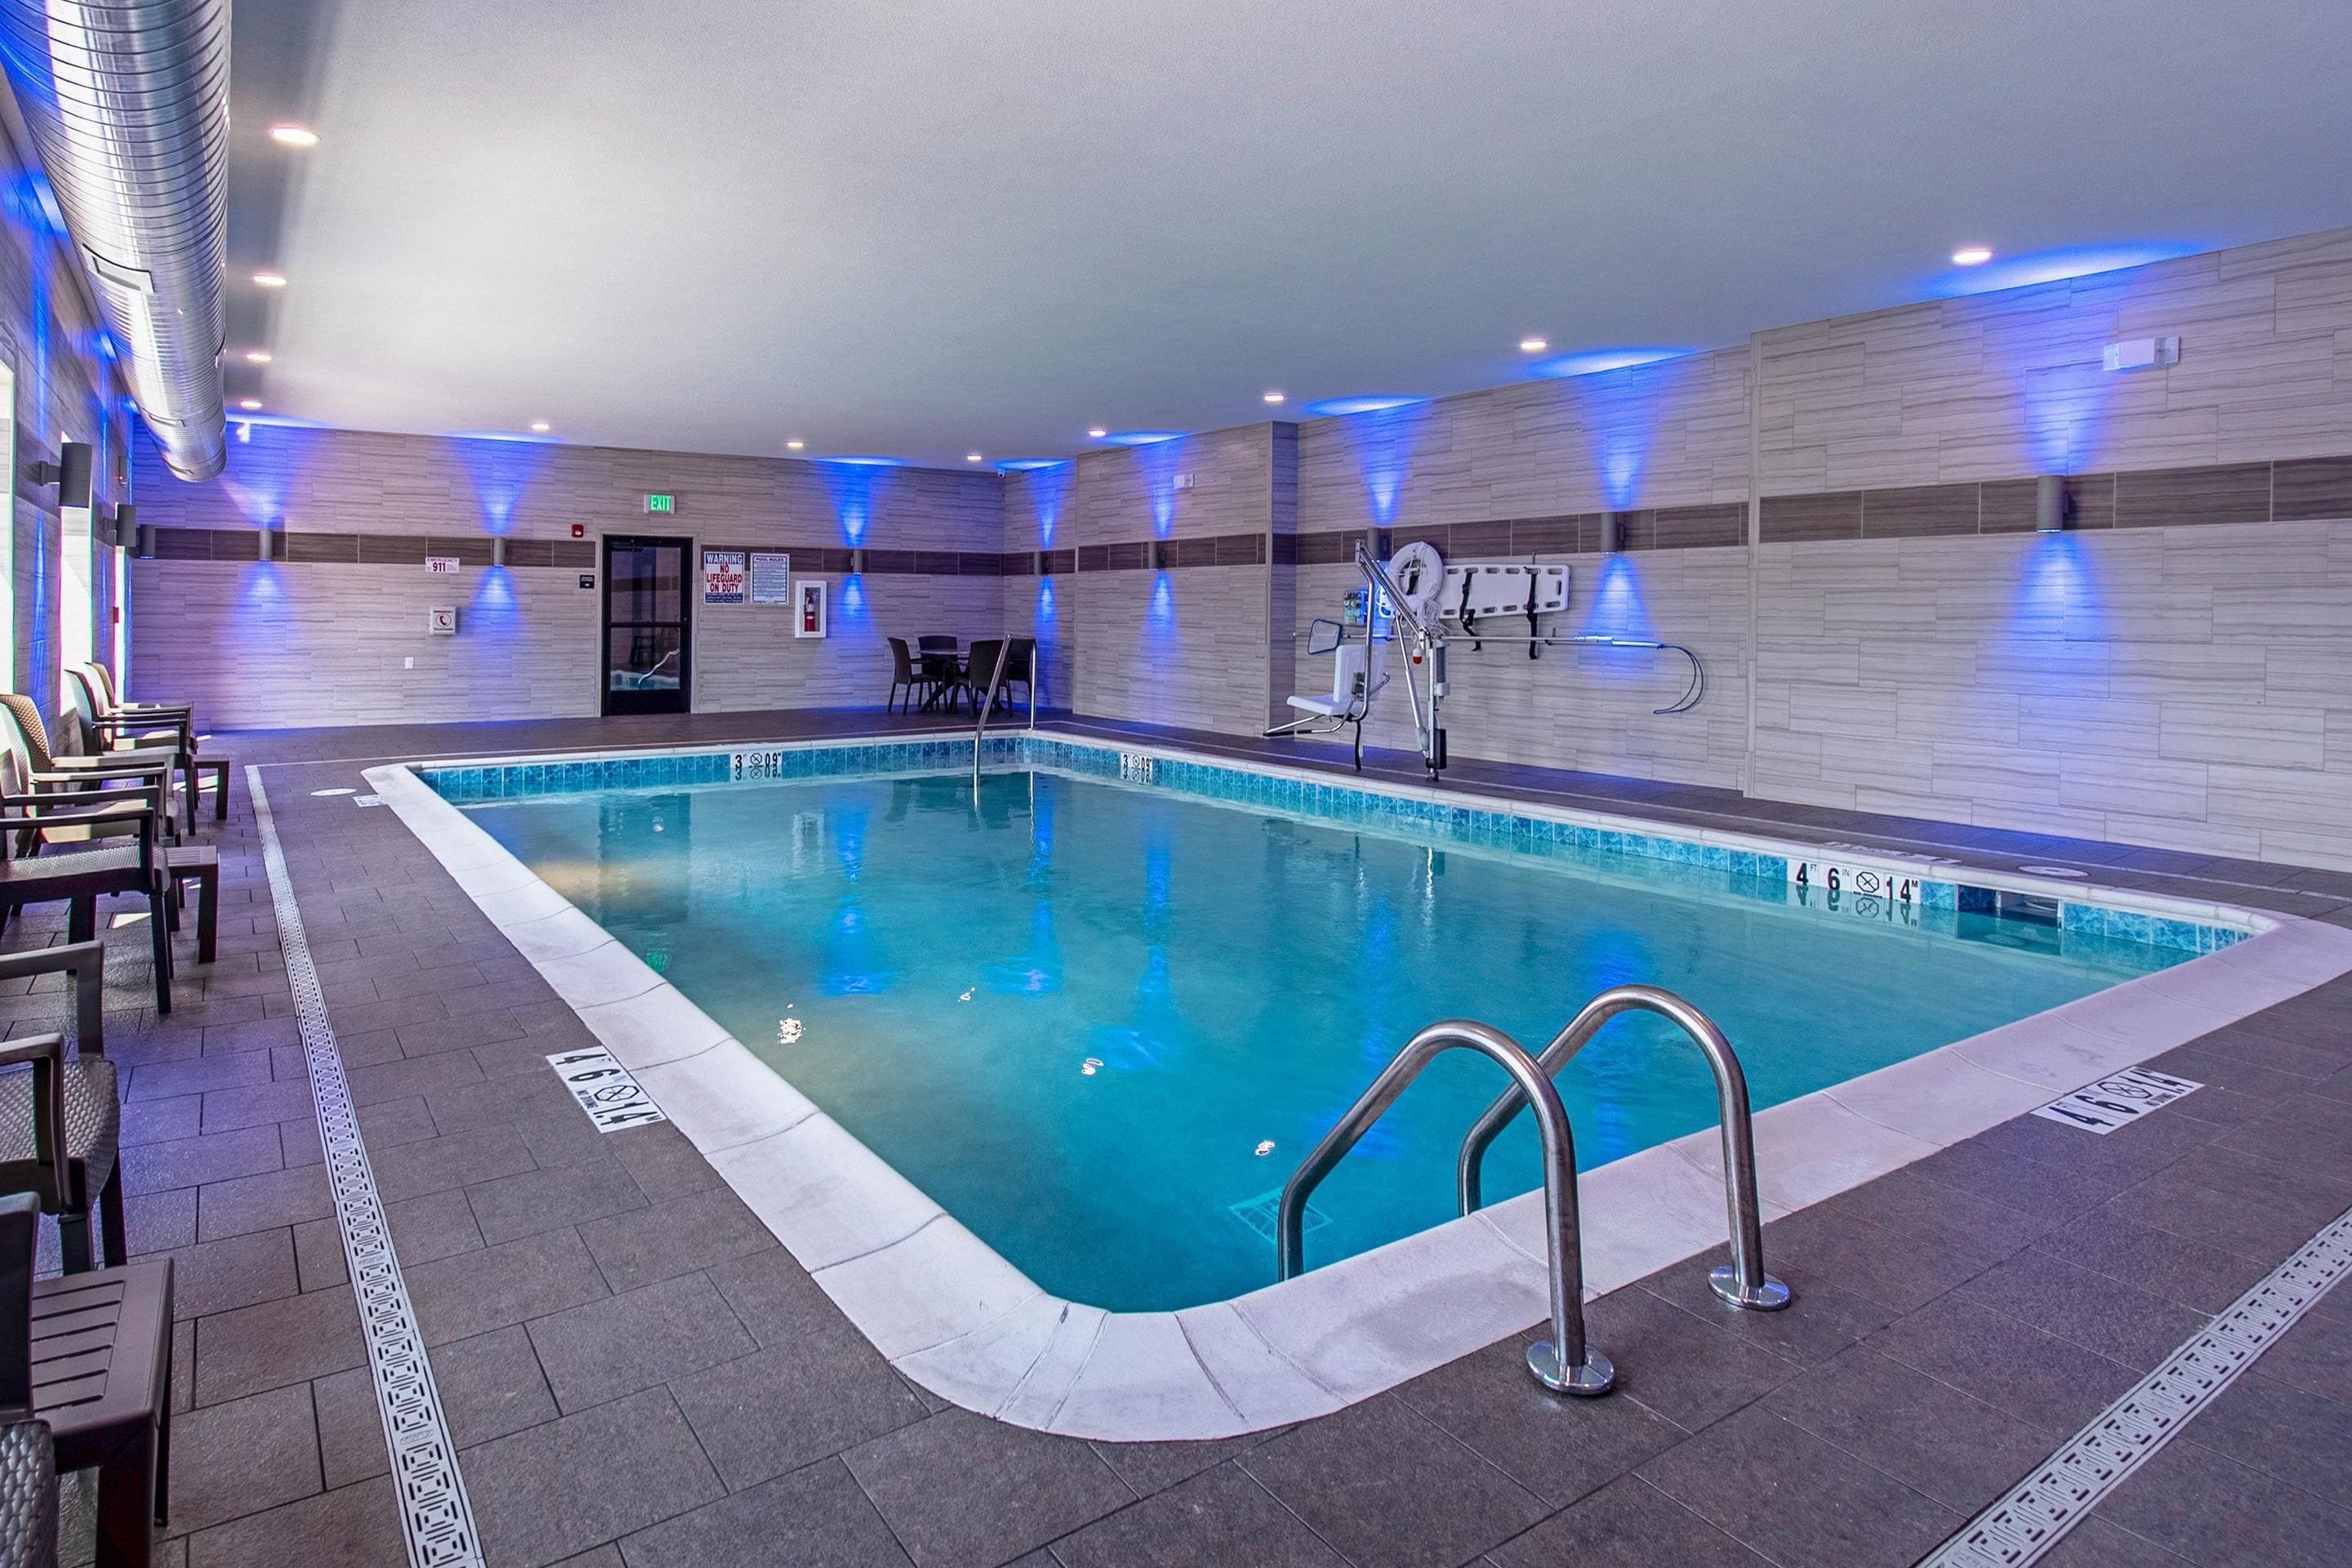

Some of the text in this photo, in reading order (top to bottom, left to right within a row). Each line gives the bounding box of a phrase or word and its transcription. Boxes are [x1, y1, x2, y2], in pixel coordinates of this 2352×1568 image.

[650, 495, 670, 510] EXIT
[706, 554, 742, 564] WARNING
[433, 562, 446, 572] 911
[719, 564, 729, 573] NO
[706, 573, 742, 583] LIFEGUARD
[710, 583, 739, 592] ON DUTY
[1796, 862, 1809, 886] 4
[1828, 867, 1840, 890] 6
[556, 1054, 608, 1065] 4
[568, 1068, 621, 1082] 6
[2074, 1095, 2140, 1114] 6
[2047, 1106, 2115, 1127] 4
